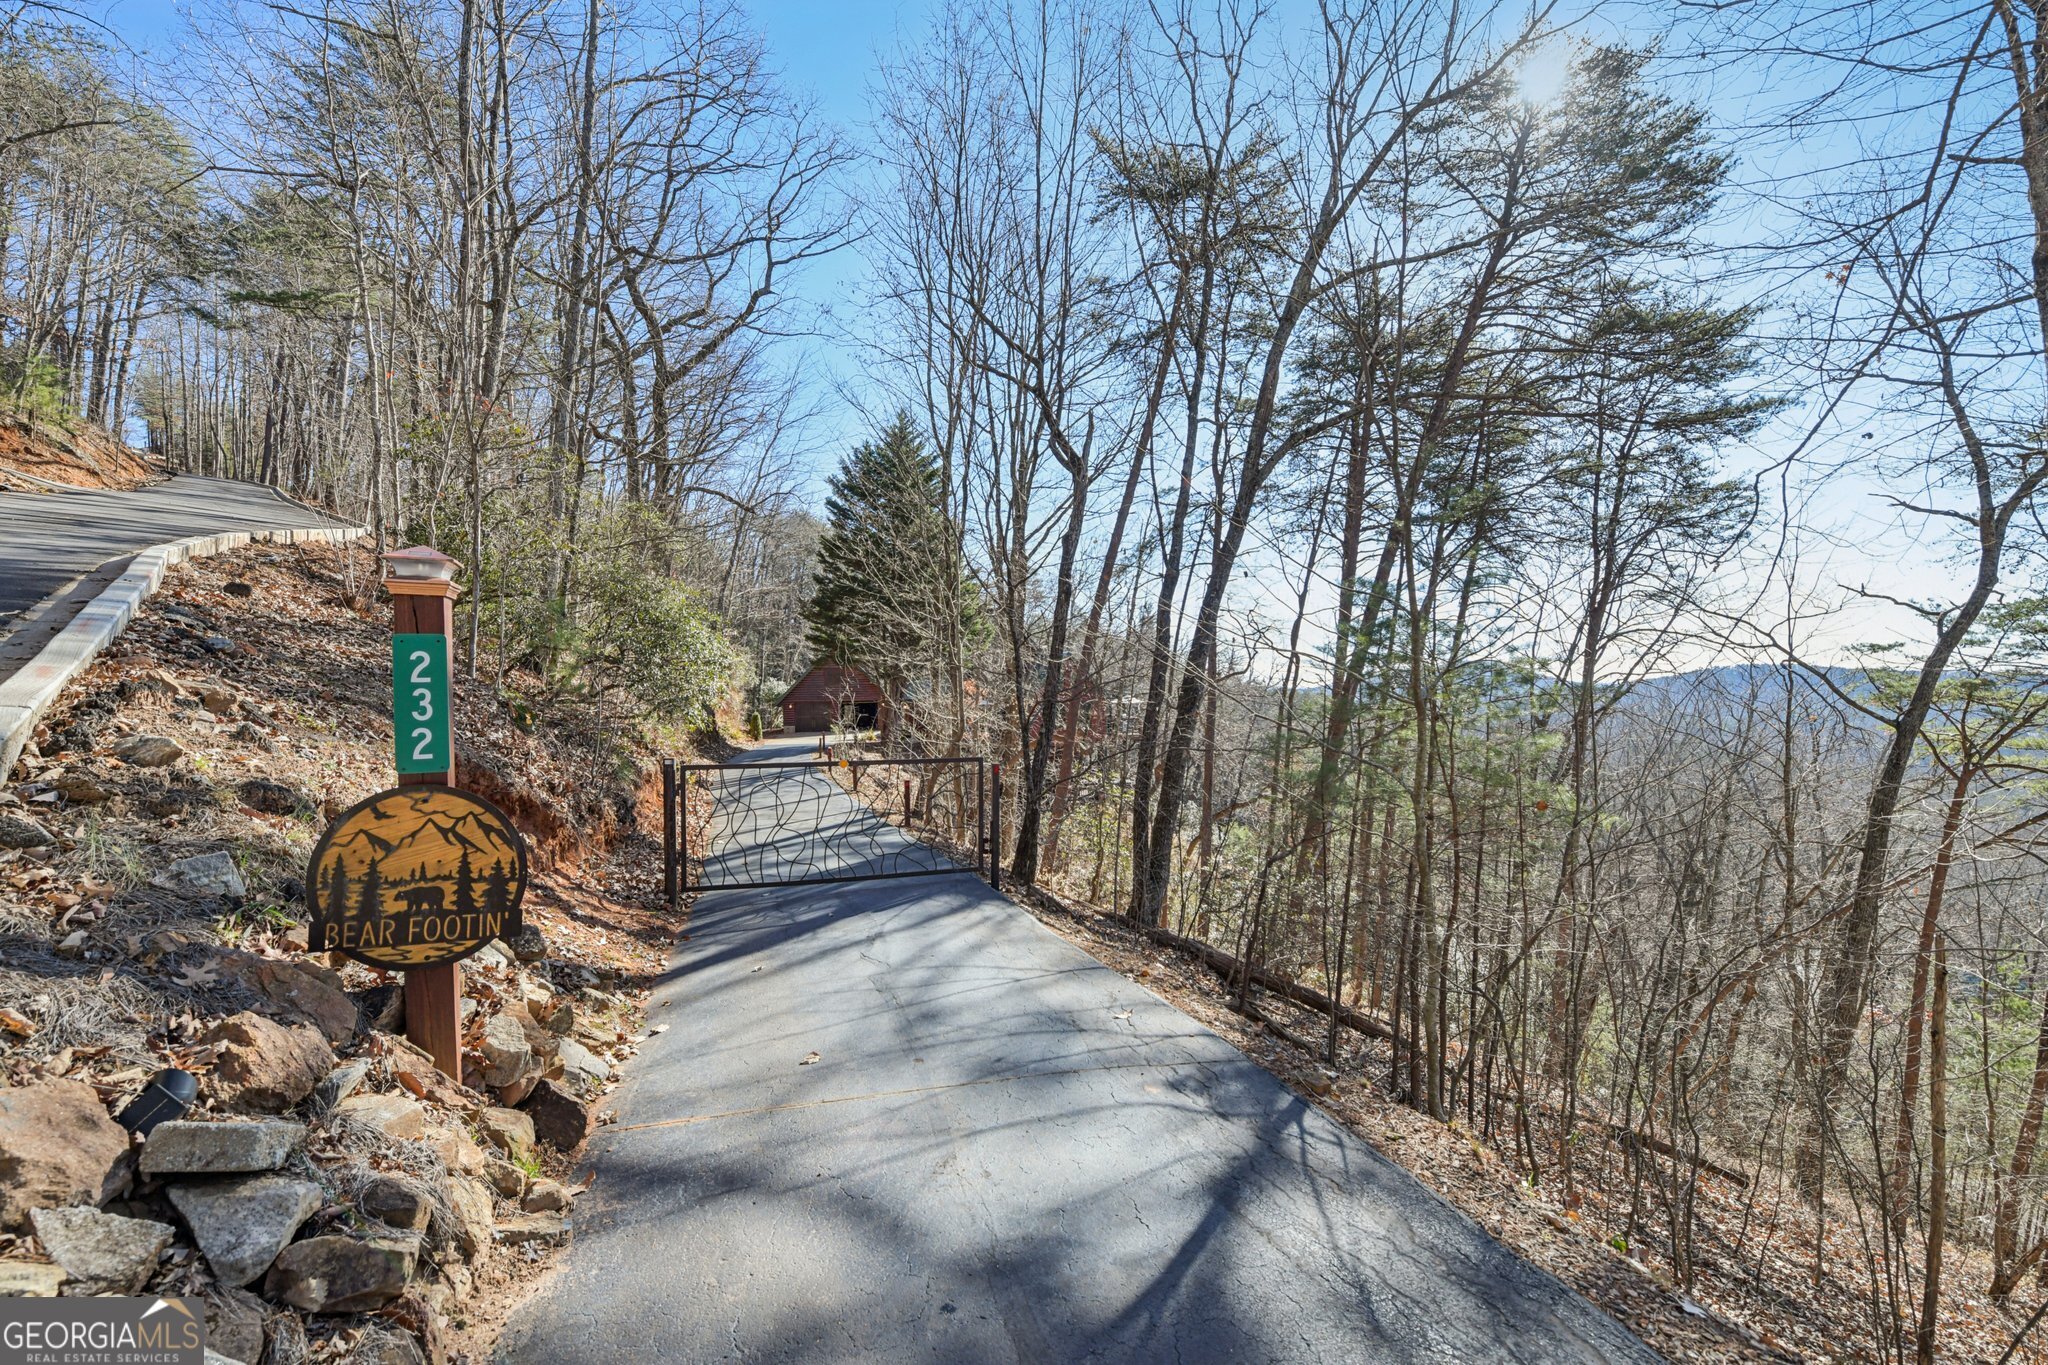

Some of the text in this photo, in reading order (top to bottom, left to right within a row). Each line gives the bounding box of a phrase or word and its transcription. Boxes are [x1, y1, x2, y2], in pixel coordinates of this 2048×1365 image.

[409, 650, 434, 760] 232
[325, 911, 510, 949] BEAR FOOTIN'
